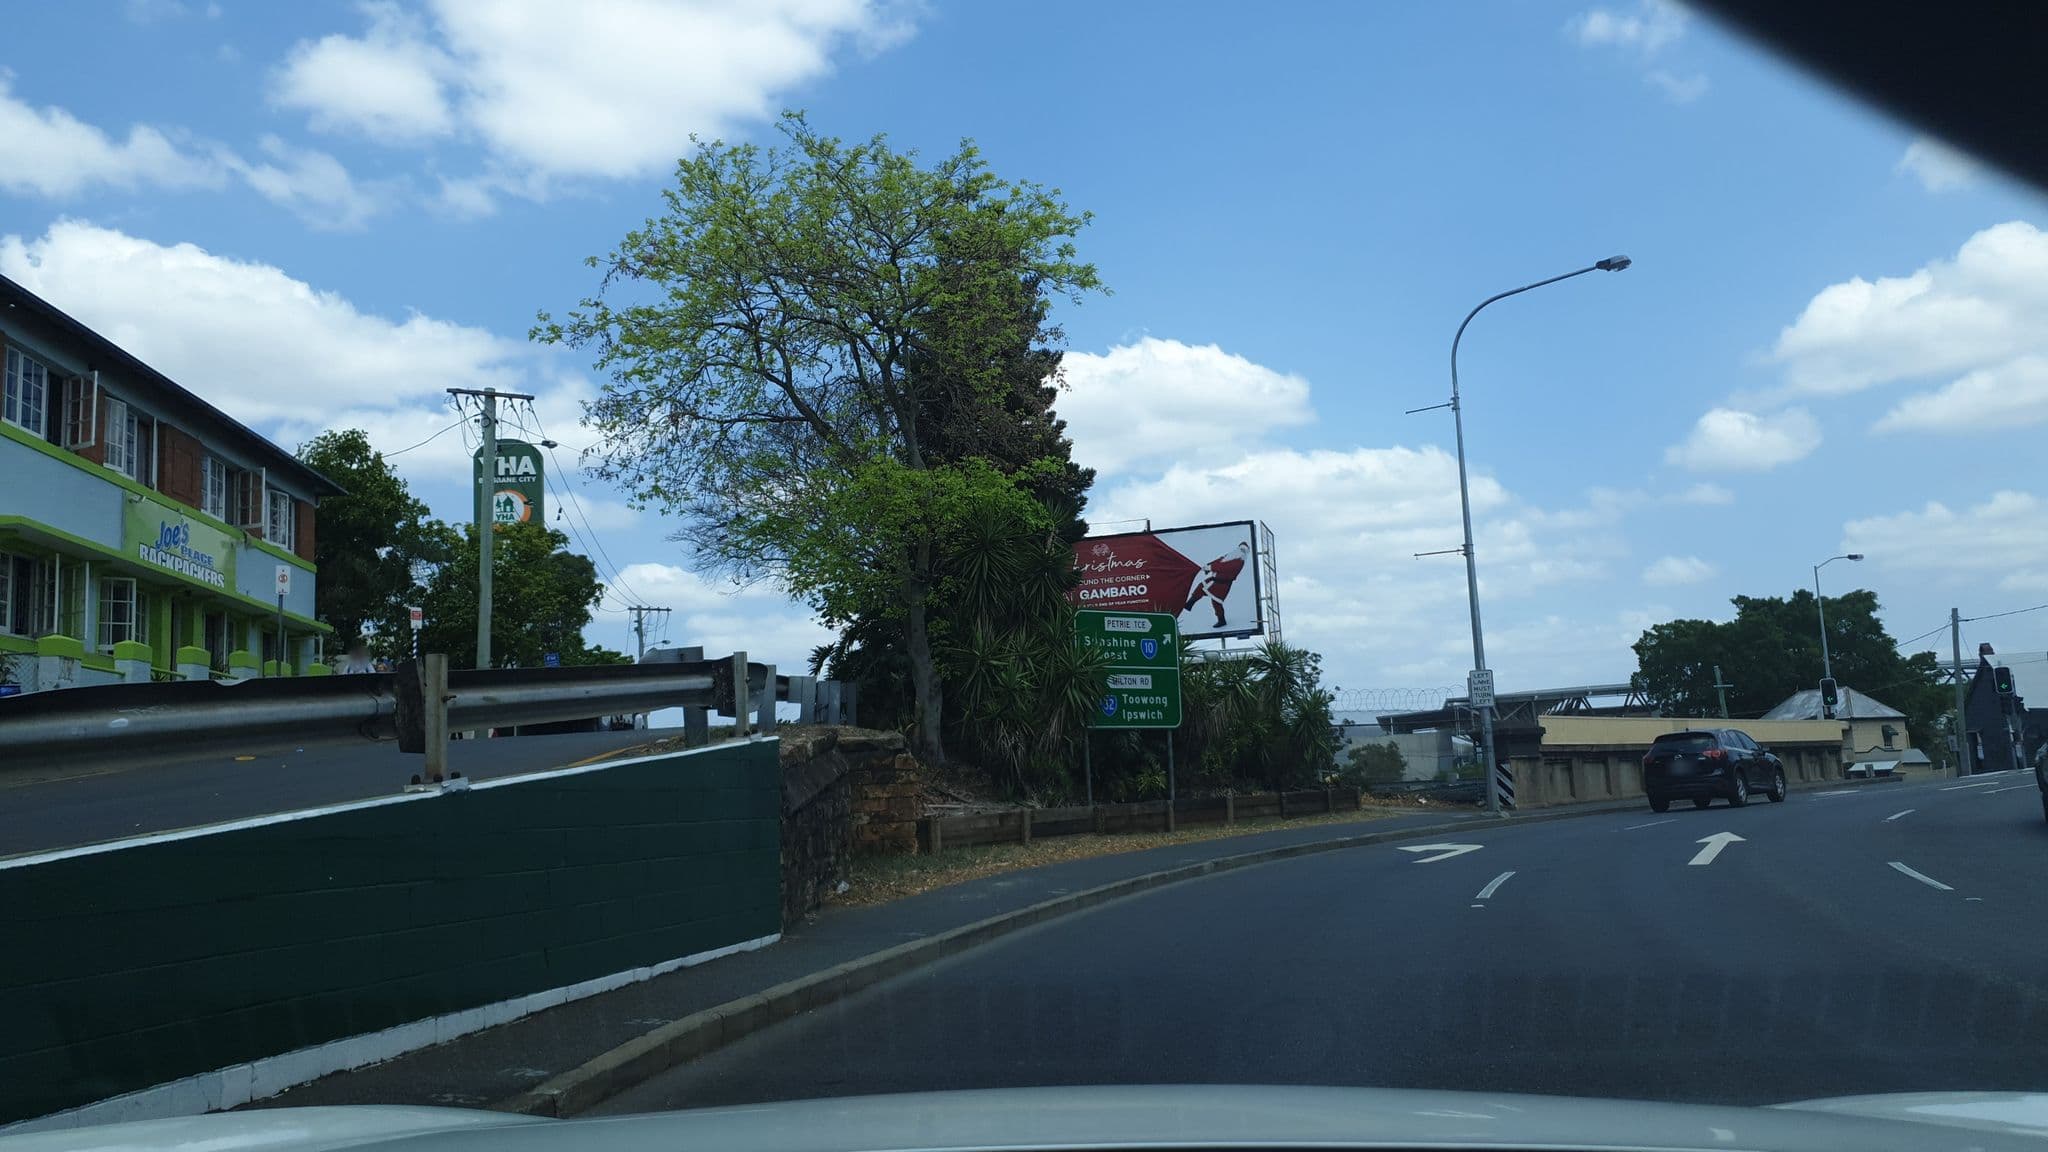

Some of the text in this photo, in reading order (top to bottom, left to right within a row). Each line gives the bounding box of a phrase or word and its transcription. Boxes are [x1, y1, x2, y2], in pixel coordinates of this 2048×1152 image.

[478, 476, 517, 484] BSBANE
[155, 518, 190, 550] Joe's
[180, 545, 214, 566] PLACE
[1072, 551, 1148, 573] hristmas
[139, 542, 225, 588] BACKPACKERS
[1115, 574, 1146, 583] CORNER
[1079, 584, 1148, 600] GAMBARO
[1106, 619, 1147, 629] PETRIE TCE
[1144, 641, 1153, 654] 10
[1139, 677, 1150, 686] RD
[1122, 693, 1168, 708] Toowong
[1122, 709, 1164, 722] Ipswich
